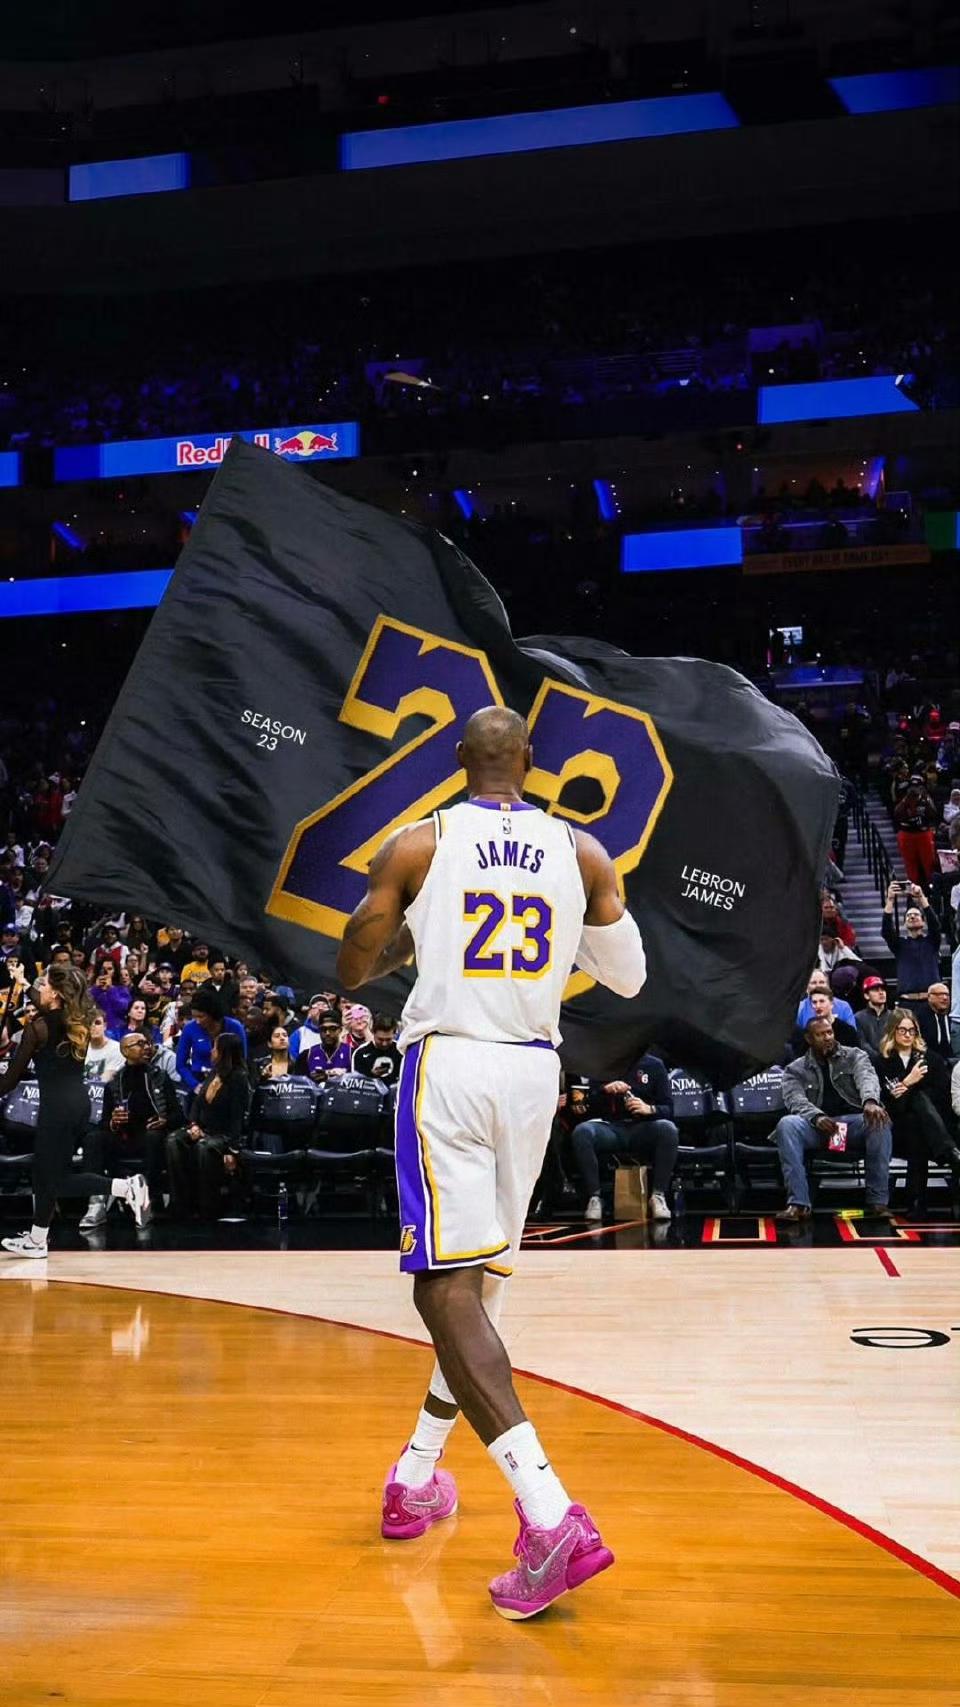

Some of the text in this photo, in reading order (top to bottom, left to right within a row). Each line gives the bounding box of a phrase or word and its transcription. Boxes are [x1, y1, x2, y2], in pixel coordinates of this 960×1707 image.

[177, 438, 224, 465] Red
[241, 709, 307, 745] SEASON
[256, 733, 278, 751] 23
[475, 840, 545, 874] JAMES
[681, 864, 746, 898] LEBRON
[681, 883, 735, 911] JAMES
[462, 889, 555, 981] 23
[272, 1083, 293, 1096] NJM
[341, 1078, 364, 1090] NJM
[671, 1078, 697, 1091] NJM
